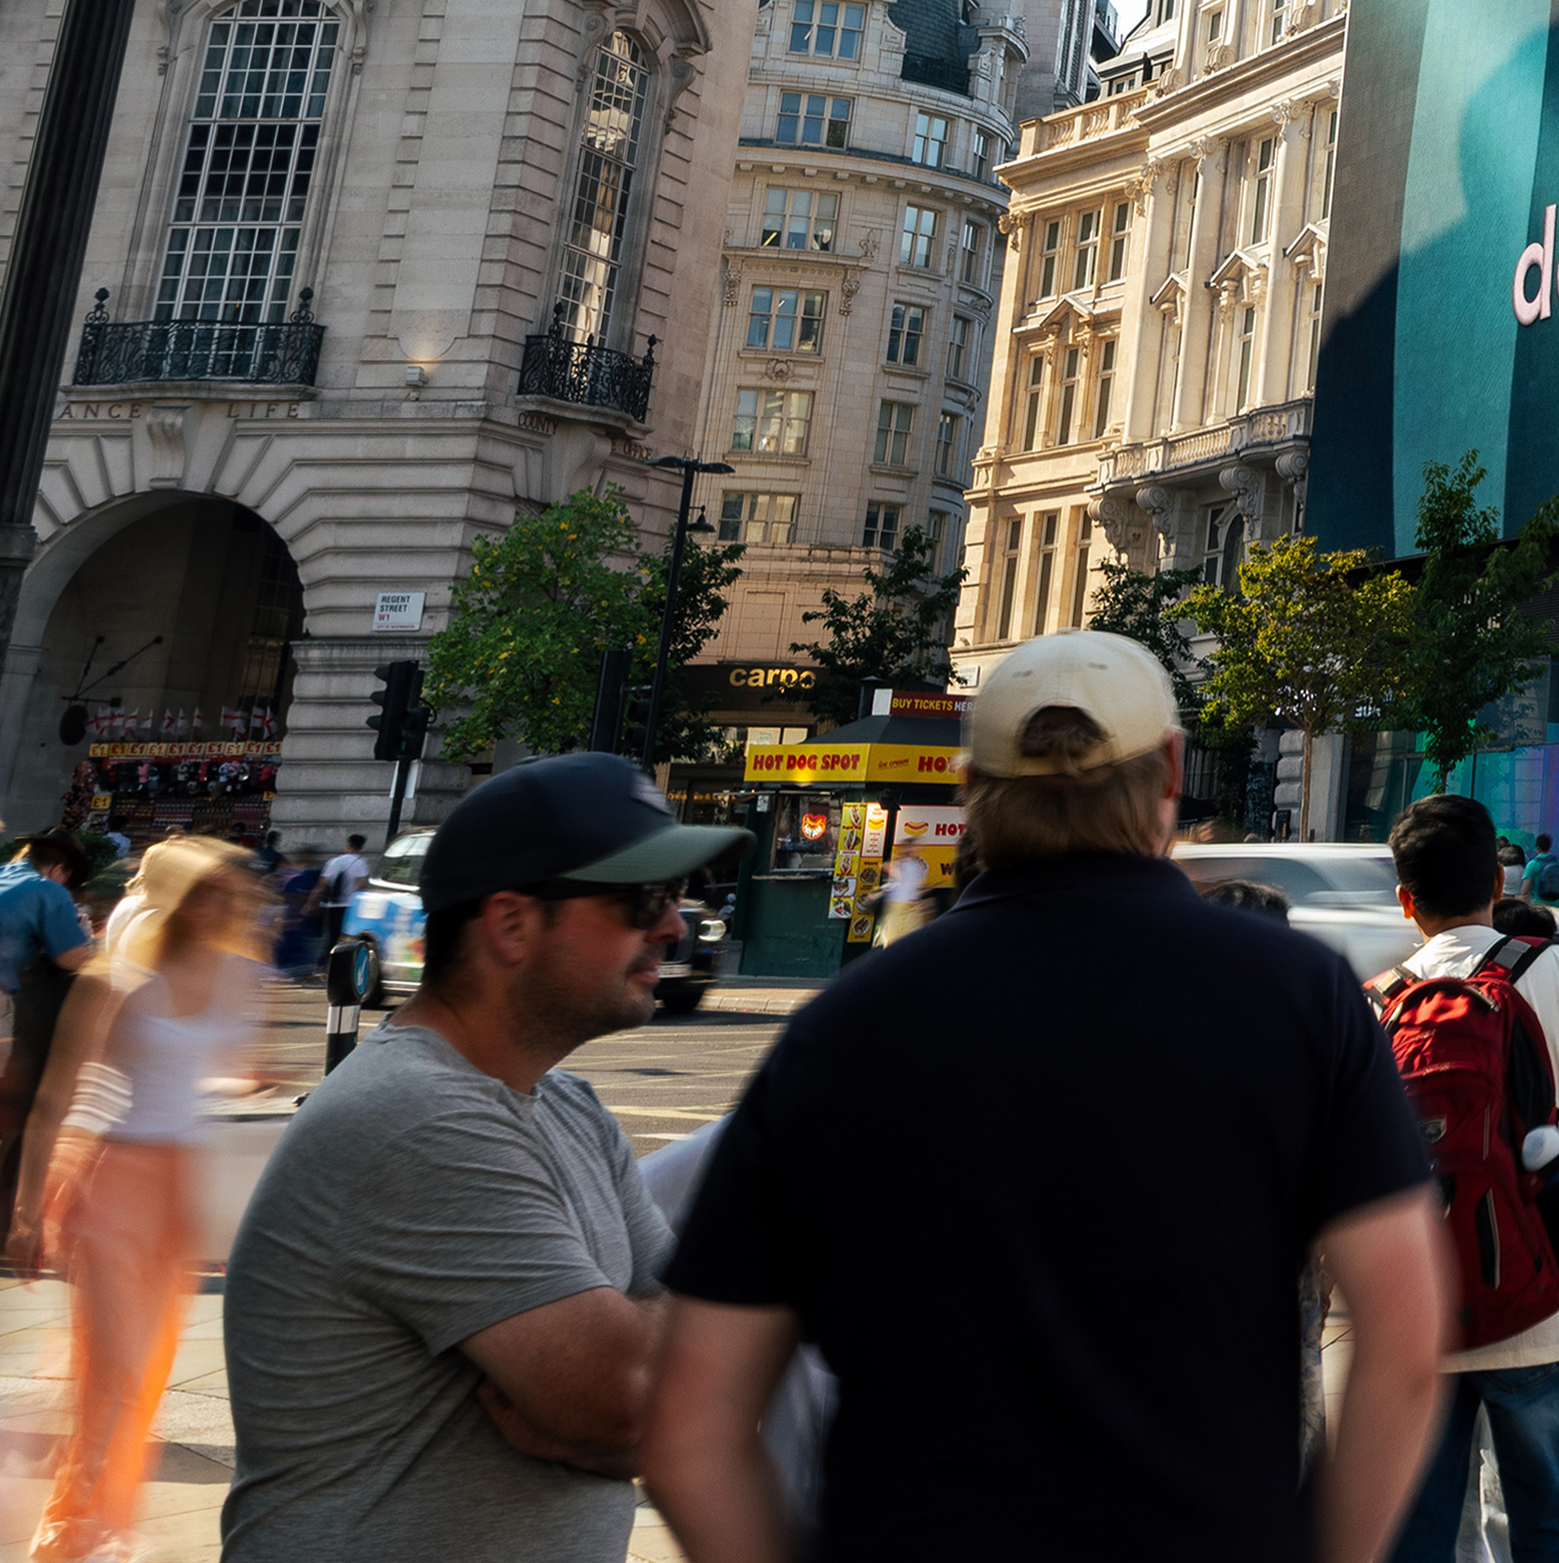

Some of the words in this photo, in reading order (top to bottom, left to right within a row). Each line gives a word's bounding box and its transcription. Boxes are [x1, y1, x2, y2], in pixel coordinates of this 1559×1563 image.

[518, 412, 560, 435] COUNTY
[381, 595, 410, 604] REGENT
[379, 604, 408, 613] STREET
[729, 668, 816, 693] carpo
[892, 698, 912, 709] BUY
[914, 699, 953, 712] TICKETS
[91, 745, 105, 755] £1
[111, 745, 125, 754] £1
[130, 744, 144, 754] £1
[150, 745, 163, 754] £1
[169, 744, 183, 754] £1
[188, 744, 202, 753] £1
[208, 743, 221, 752] £1
[226, 744, 240, 754] £1
[246, 742, 260, 752] £1
[266, 743, 280, 753] £1
[752, 754, 783, 771] HOT
[786, 754, 818, 771] DOG
[821, 754, 860, 771] SPOT
[93, 797, 107, 807] £1
